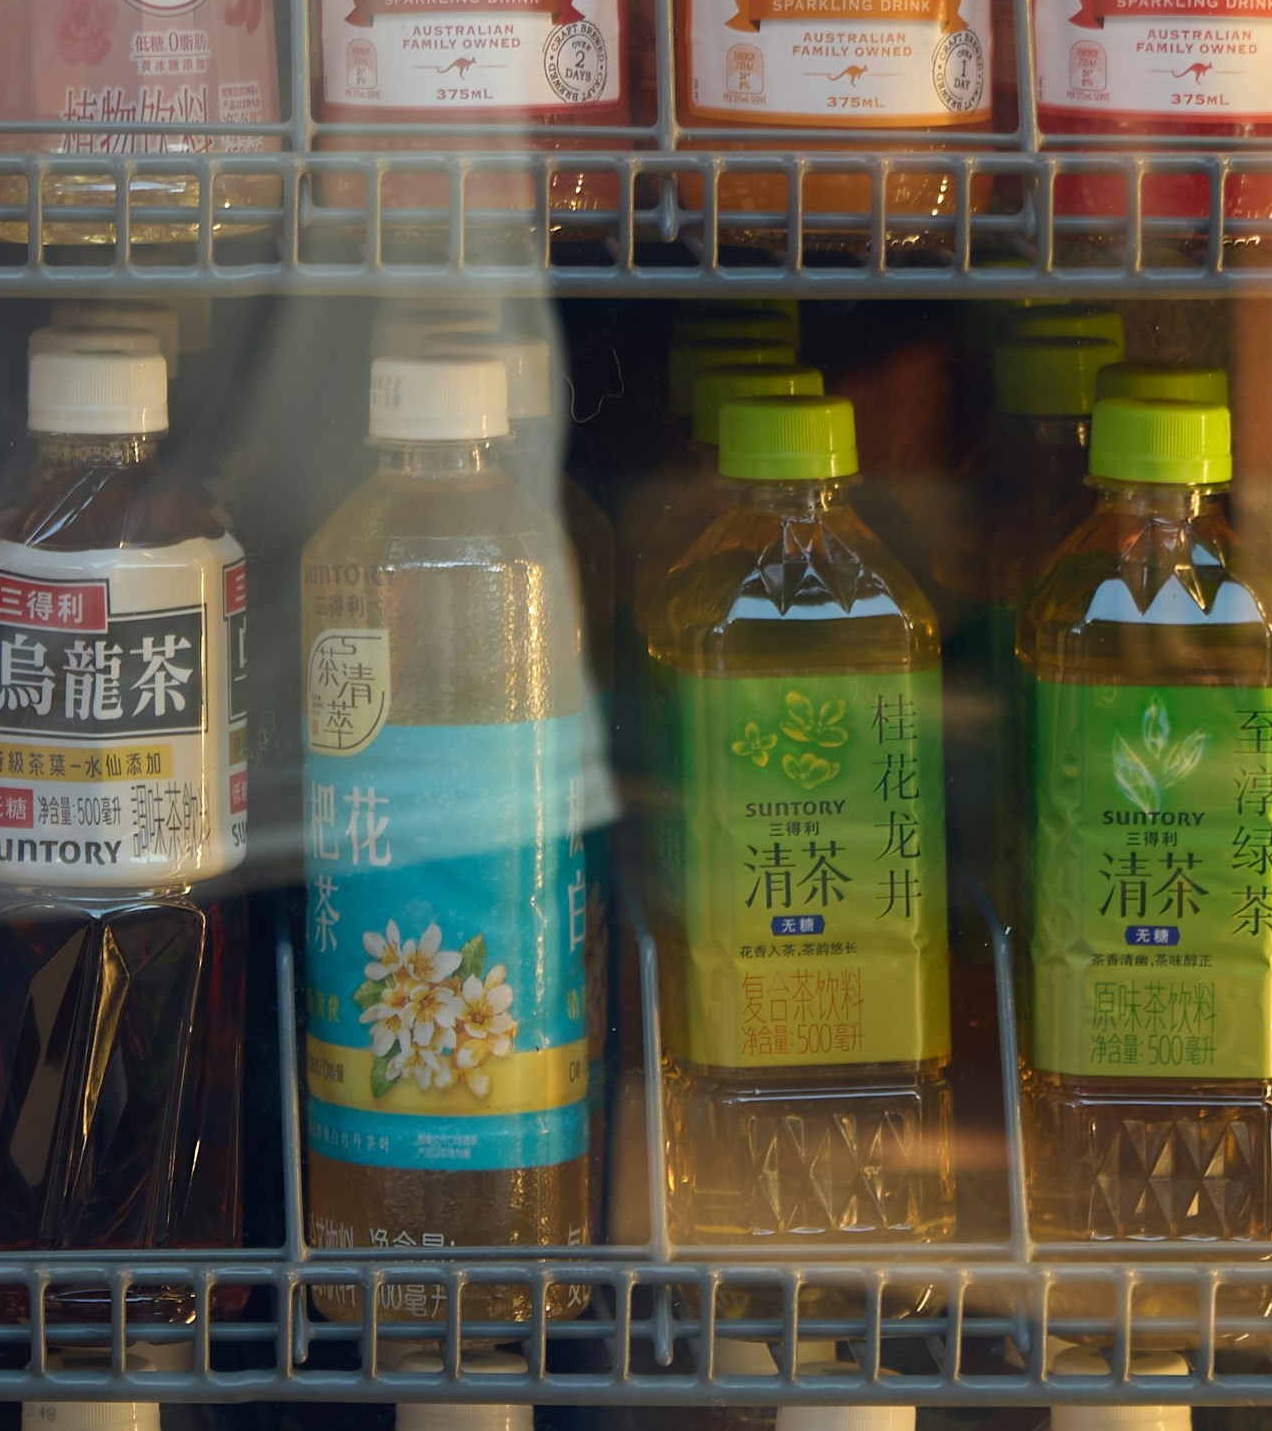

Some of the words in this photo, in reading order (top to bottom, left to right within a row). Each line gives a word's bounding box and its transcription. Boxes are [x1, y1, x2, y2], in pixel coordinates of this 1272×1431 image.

[565, 68, 593, 83] DAYS
[745, 800, 847, 818] SUNTORY
[869, 693, 923, 920] 桂花龙井
[1102, 809, 1206, 827] SUNTORY
[742, 841, 853, 911] 清茶
[1098, 851, 1210, 920] 清茶
[781, 917, 815, 935] 无糖
[741, 967, 865, 1025] 复合茶饮料
[1090, 980, 1217, 1035] 原味茶饮料
